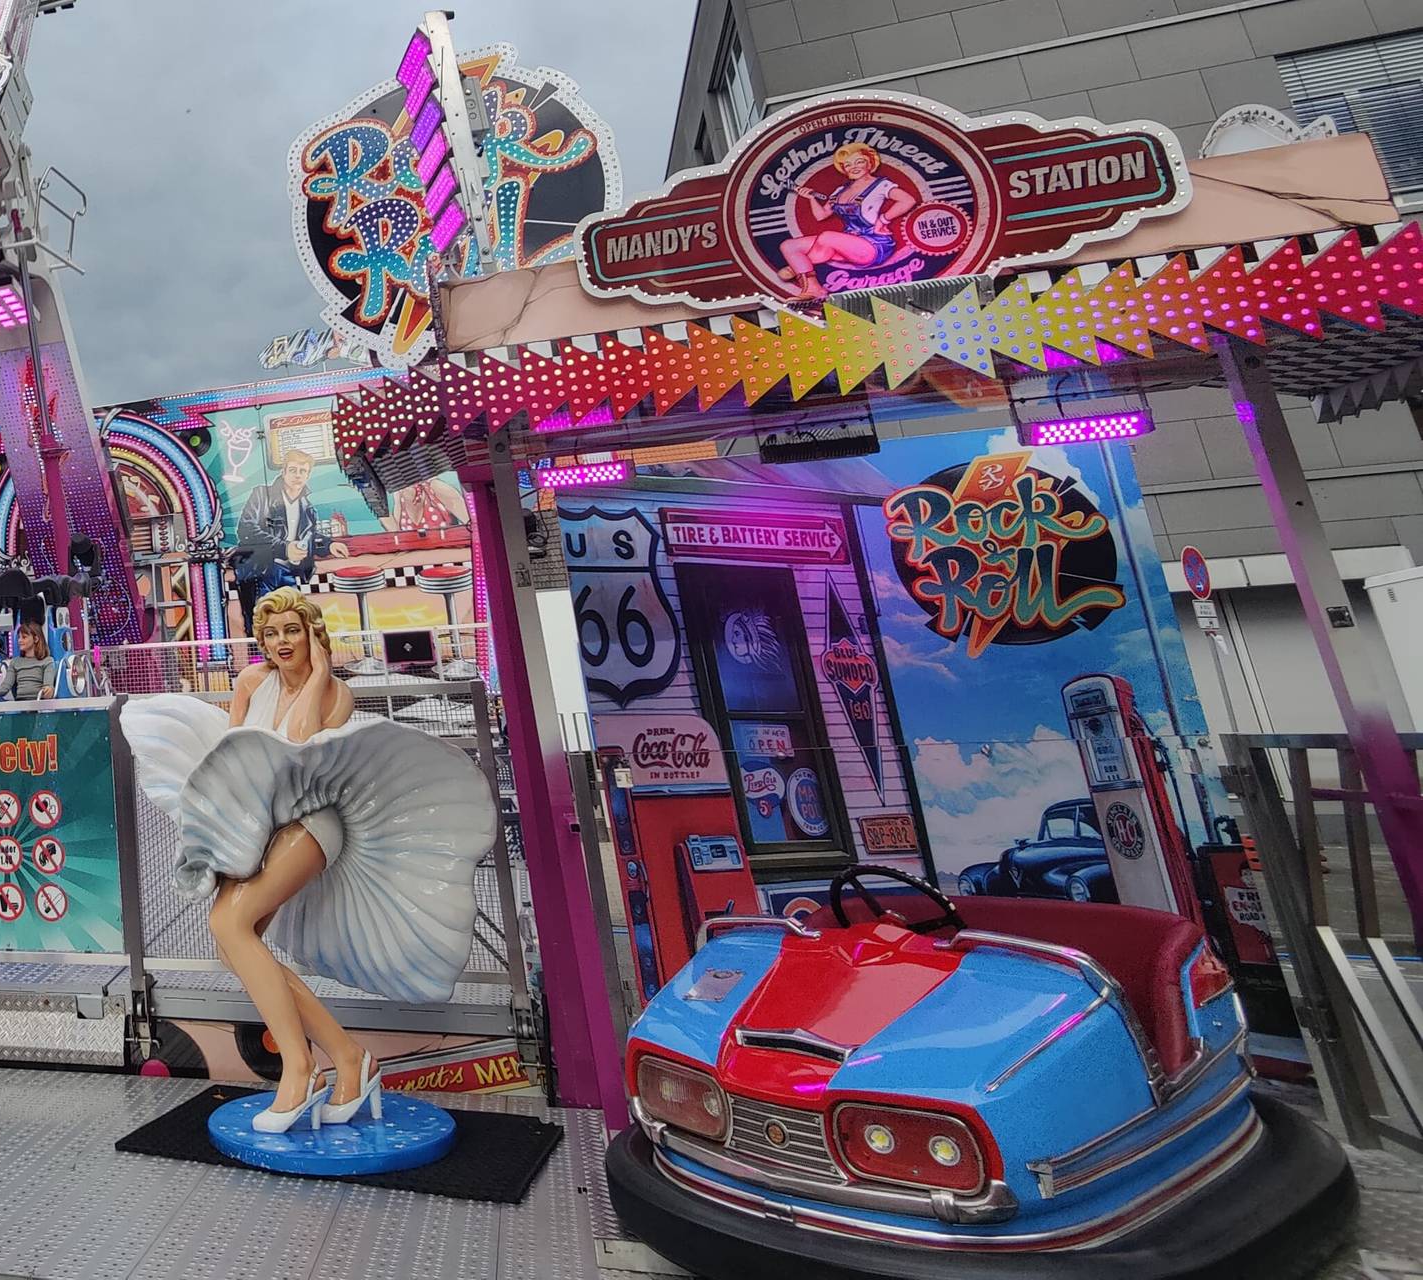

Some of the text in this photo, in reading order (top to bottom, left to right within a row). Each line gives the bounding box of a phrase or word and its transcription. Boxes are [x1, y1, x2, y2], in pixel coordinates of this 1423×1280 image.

[301, 83, 598, 228] Rok
[759, 127, 948, 200] Lethal Threat
[1007, 151, 1147, 200] STATION
[917, 221, 928, 231] IN
[938, 216, 954, 228] OUT
[920, 225, 958, 240] SERVICE
[605, 220, 719, 265] MANDY'S
[823, 257, 925, 292] Garage
[882, 466, 1109, 564] Rock
[565, 529, 635, 560] U S
[672, 525, 838, 549] TIRE & BATTERY SERVICE
[911, 538, 1127, 634] Roll
[576, 584, 656, 668] 66
[833, 647, 859, 660] BLUE
[825, 658, 875, 683] SUNOCO
[646, 727, 676, 736] DRINK
[748, 738, 786, 752] OPEN
[632, 732, 711, 769] Coca-Cola
[649, 771, 660, 780] IN
